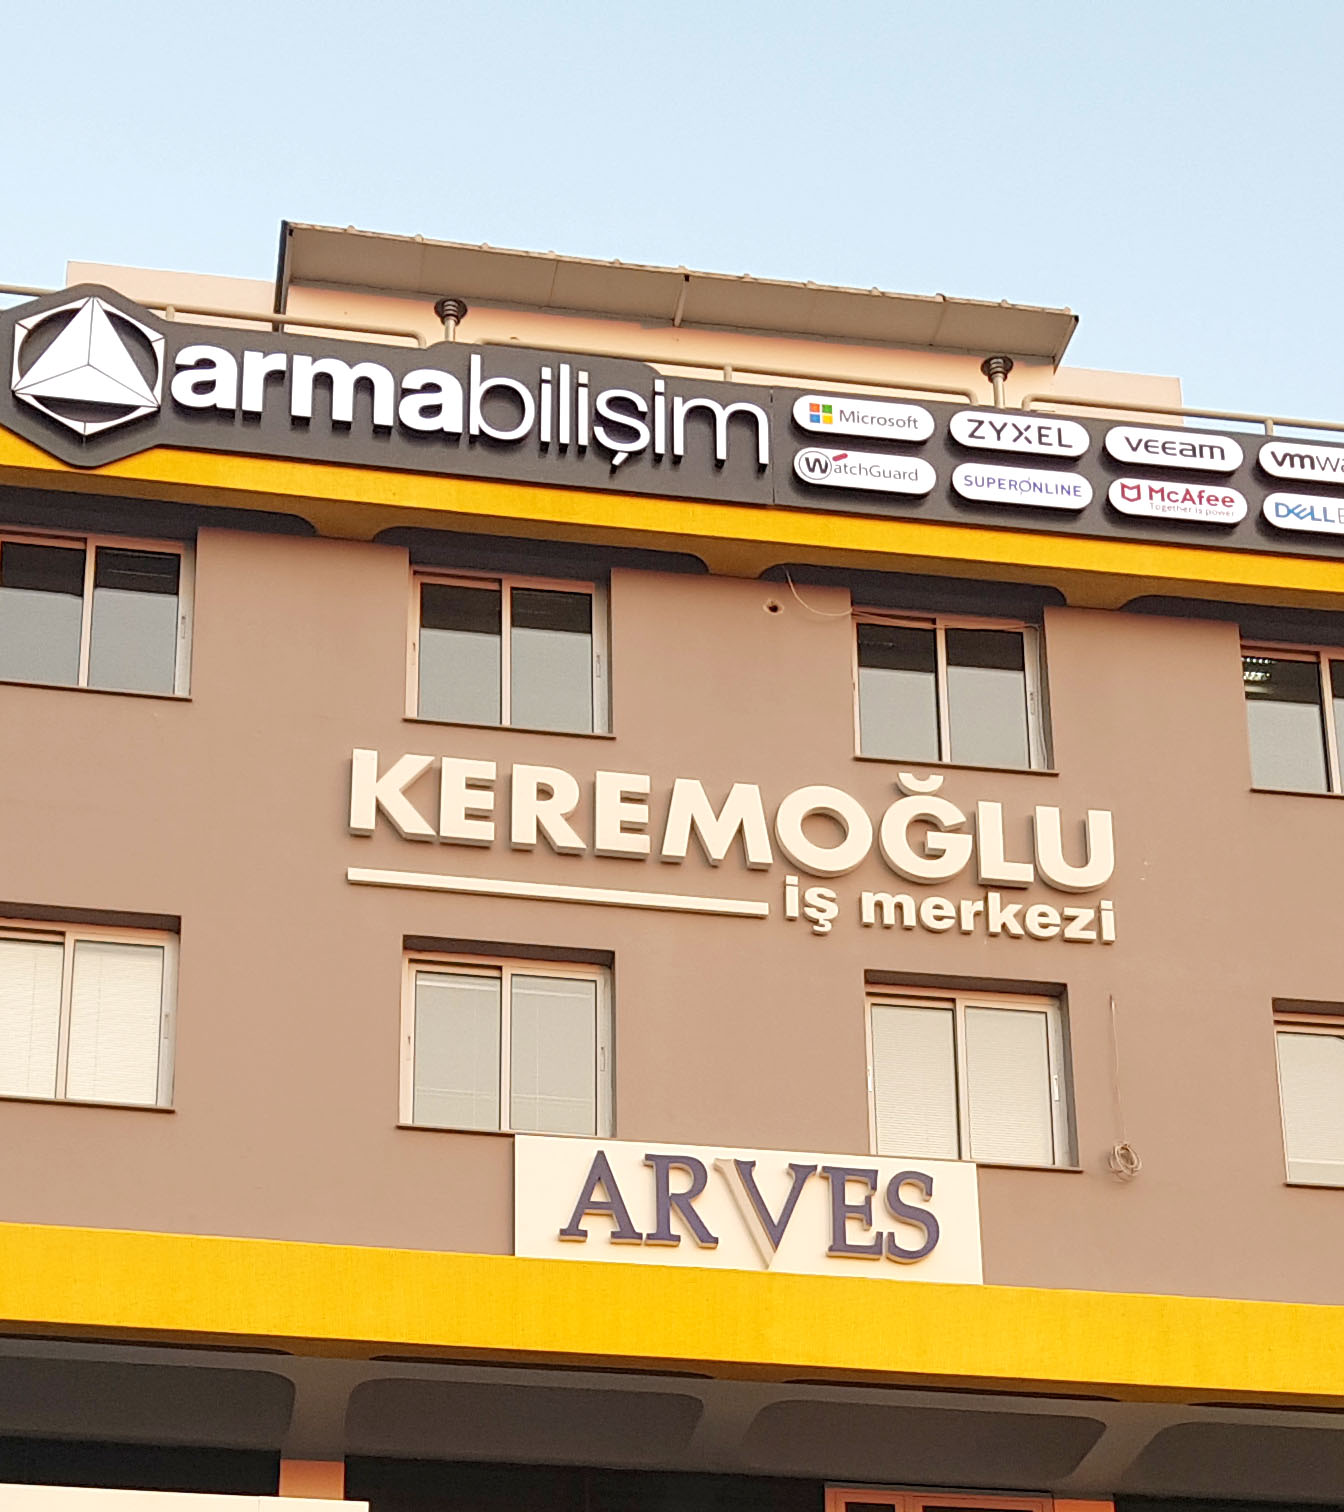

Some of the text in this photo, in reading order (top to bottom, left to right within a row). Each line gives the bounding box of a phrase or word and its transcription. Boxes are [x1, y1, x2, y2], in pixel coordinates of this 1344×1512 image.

[170, 344, 770, 470] armabilişim
[839, 407, 919, 431] Microsoft
[967, 418, 1073, 450] ZYXEL
[800, 453, 919, 482] WatchGuard
[963, 473, 1083, 498] SUPERONLINE
[1148, 485, 1235, 508] McAfee
[1149, 502, 1192, 514] Together
[1205, 508, 1235, 518] power
[347, 747, 1116, 893] KEREMOĞLU
[785, 875, 1116, 945] iş merkezi
[558, 1150, 941, 1268] ARVES
